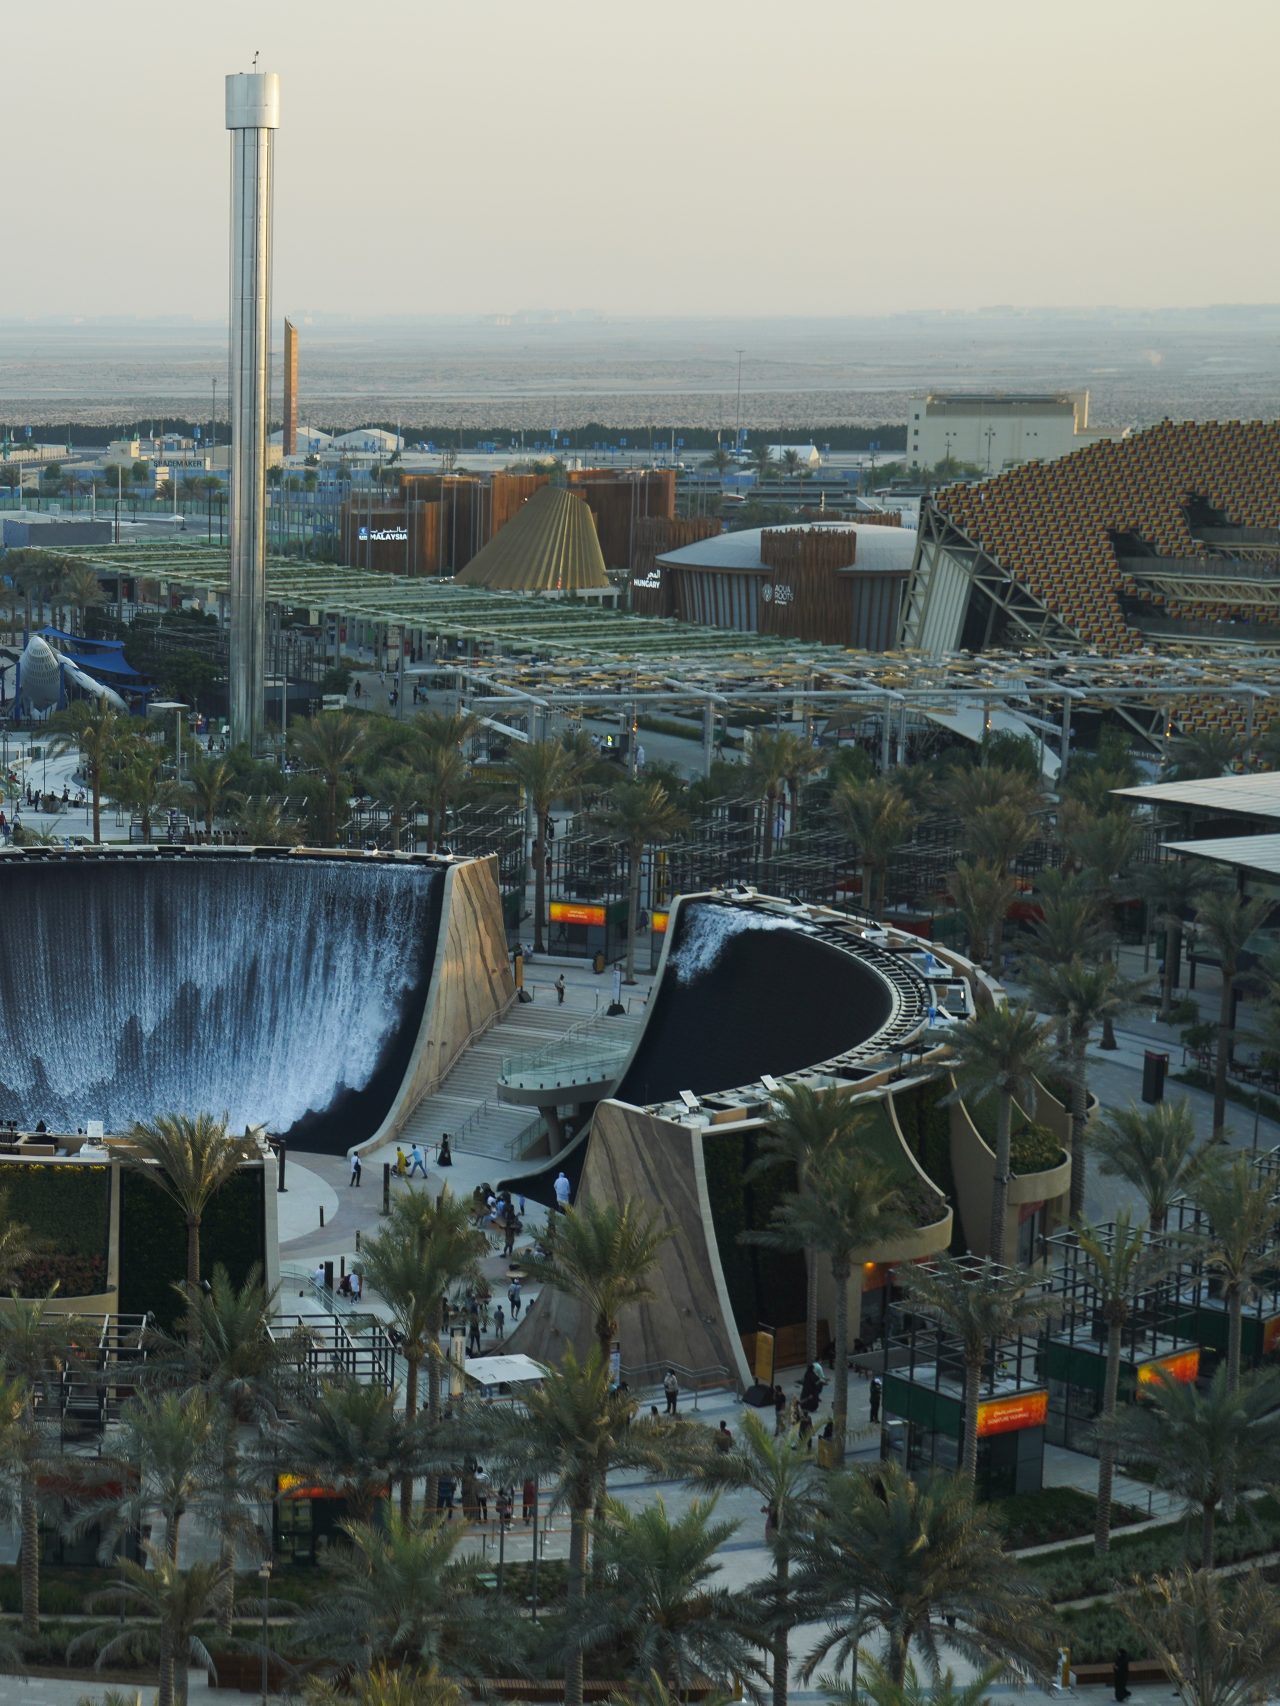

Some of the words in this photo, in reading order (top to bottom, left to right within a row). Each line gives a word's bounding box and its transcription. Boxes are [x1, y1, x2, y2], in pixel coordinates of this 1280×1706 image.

[370, 533, 408, 541] MALAYSIA
[633, 579, 660, 589] HUNGARY
[774, 591, 794, 601] ROOTS
